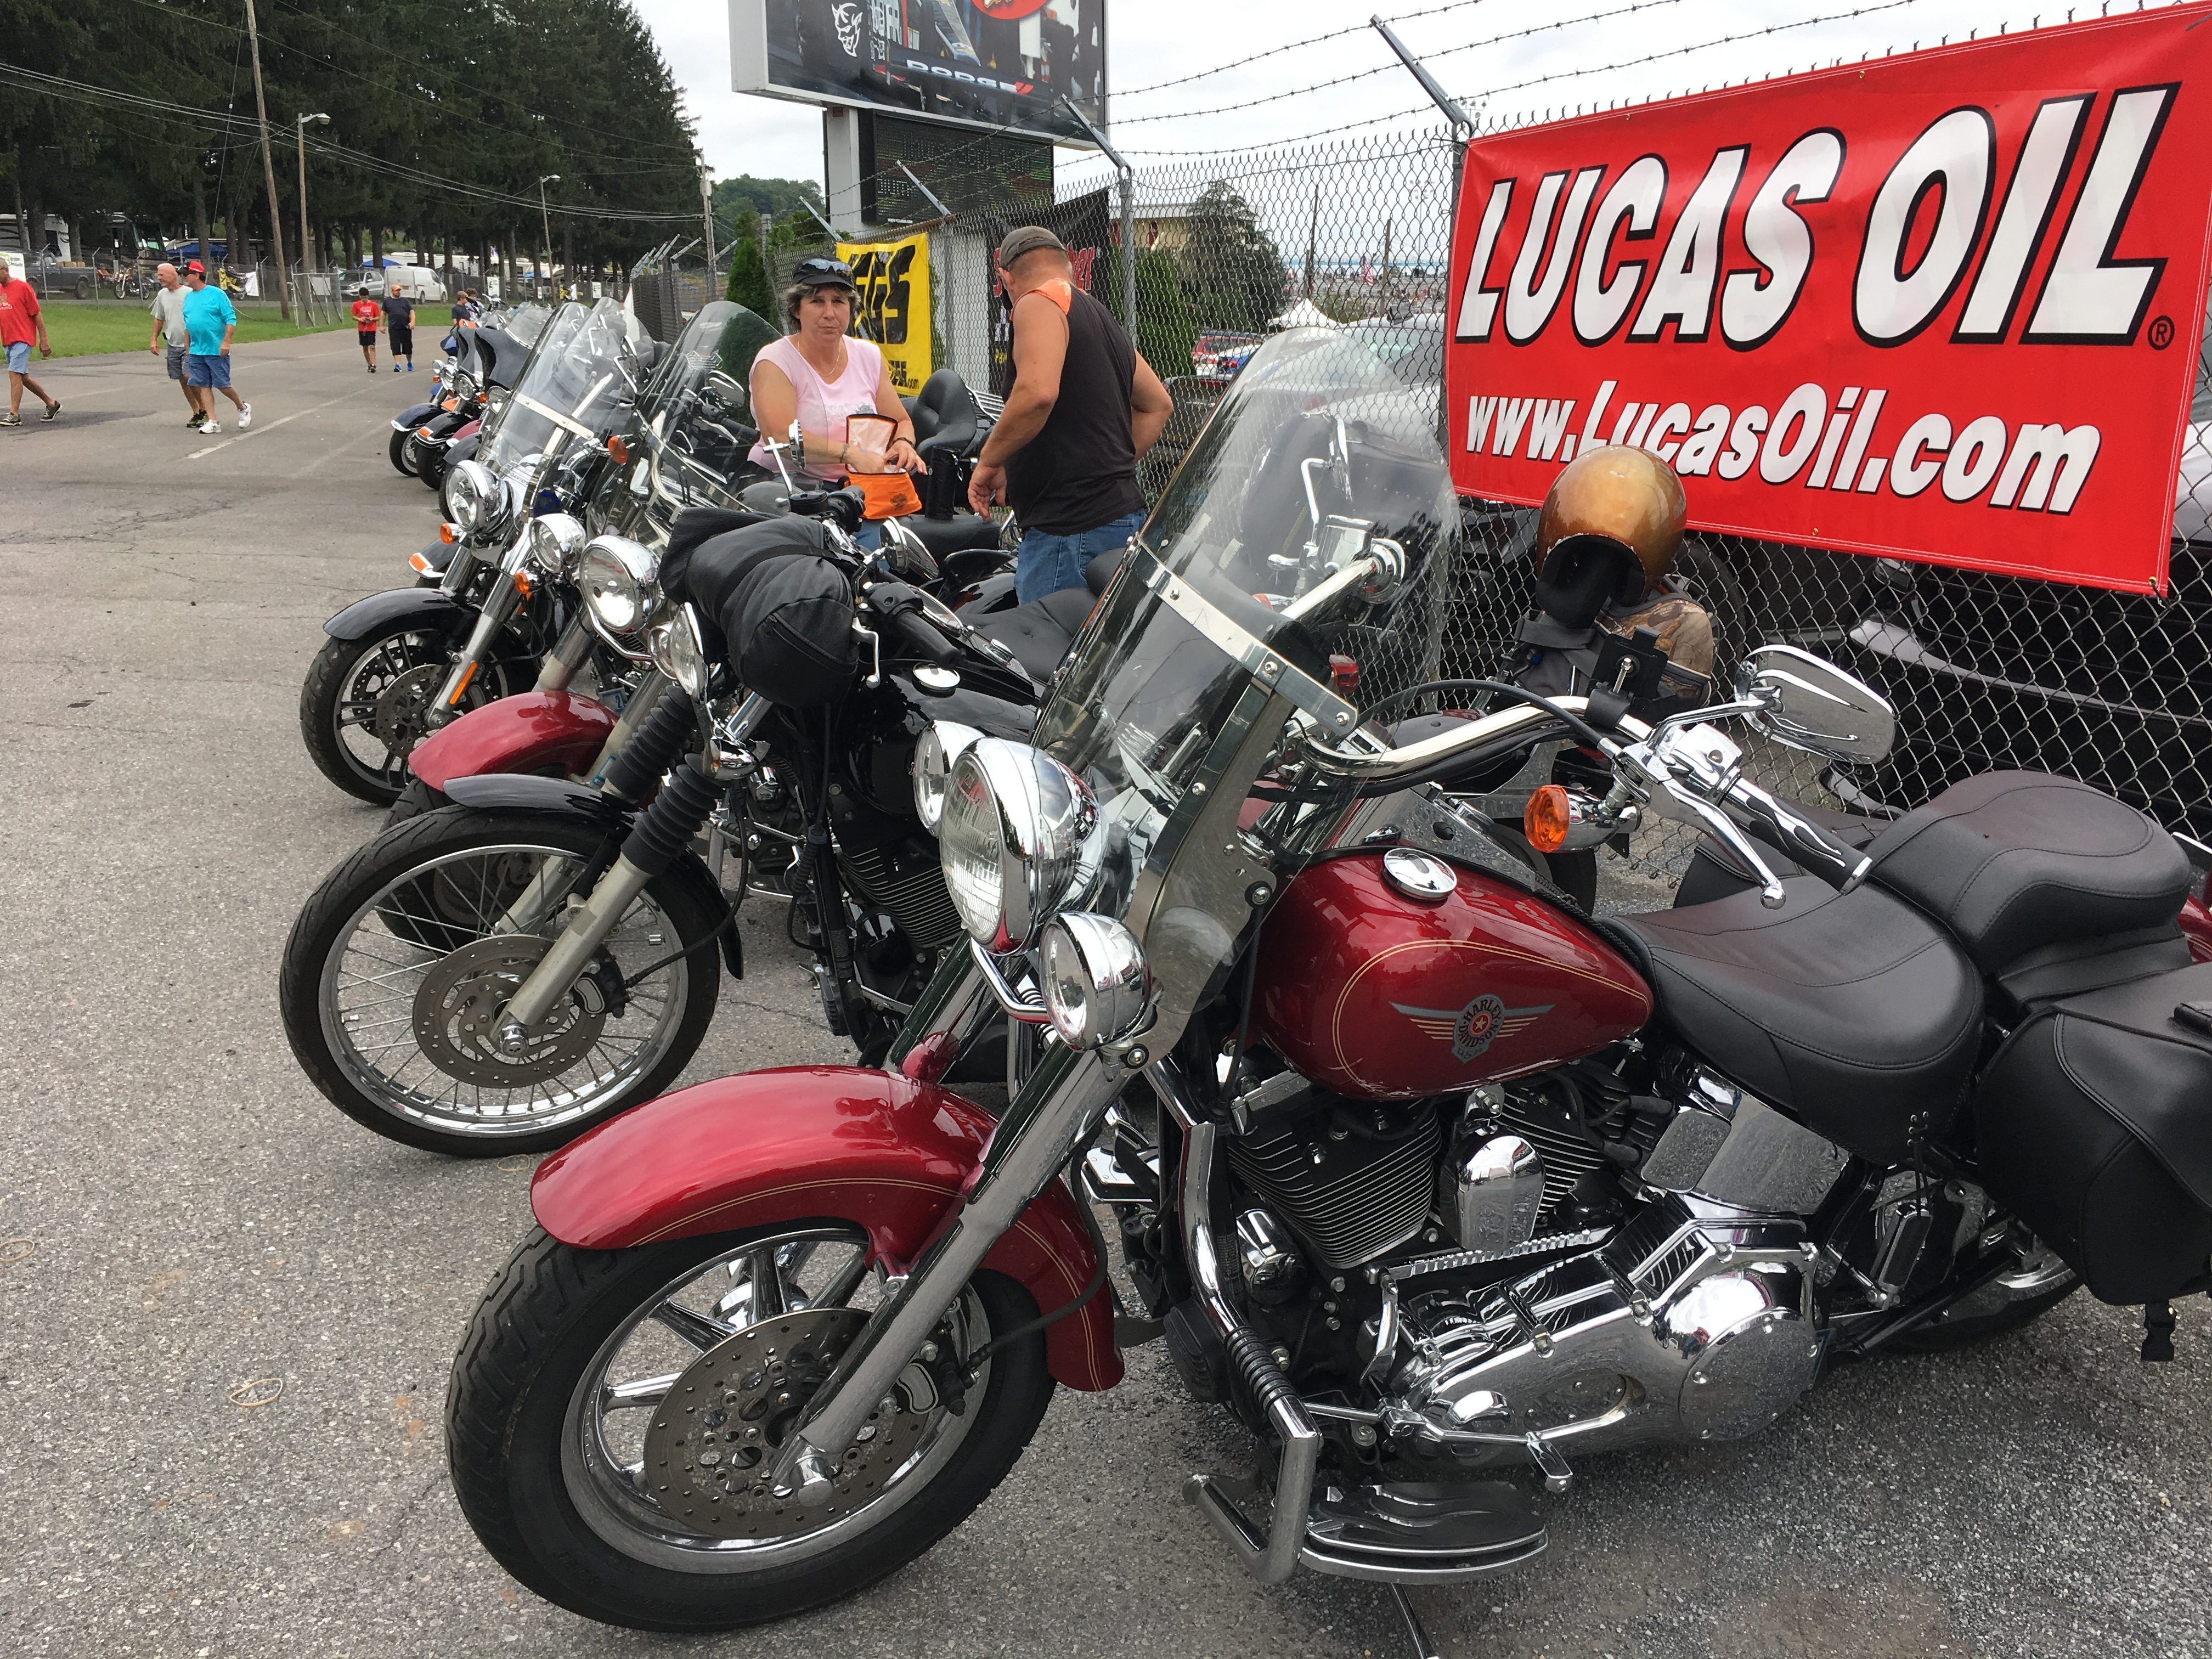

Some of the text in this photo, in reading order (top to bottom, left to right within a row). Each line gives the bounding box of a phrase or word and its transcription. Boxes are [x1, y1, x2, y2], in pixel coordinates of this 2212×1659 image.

[906, 59, 1018, 93] DODGE
[1454, 81, 2182, 352] LUCAS OIL
[1466, 379, 2102, 516] www.LucasOil.com
[1463, 998, 1502, 1022] HARLEY
[1458, 1023, 1499, 1048] DAVIDSON
